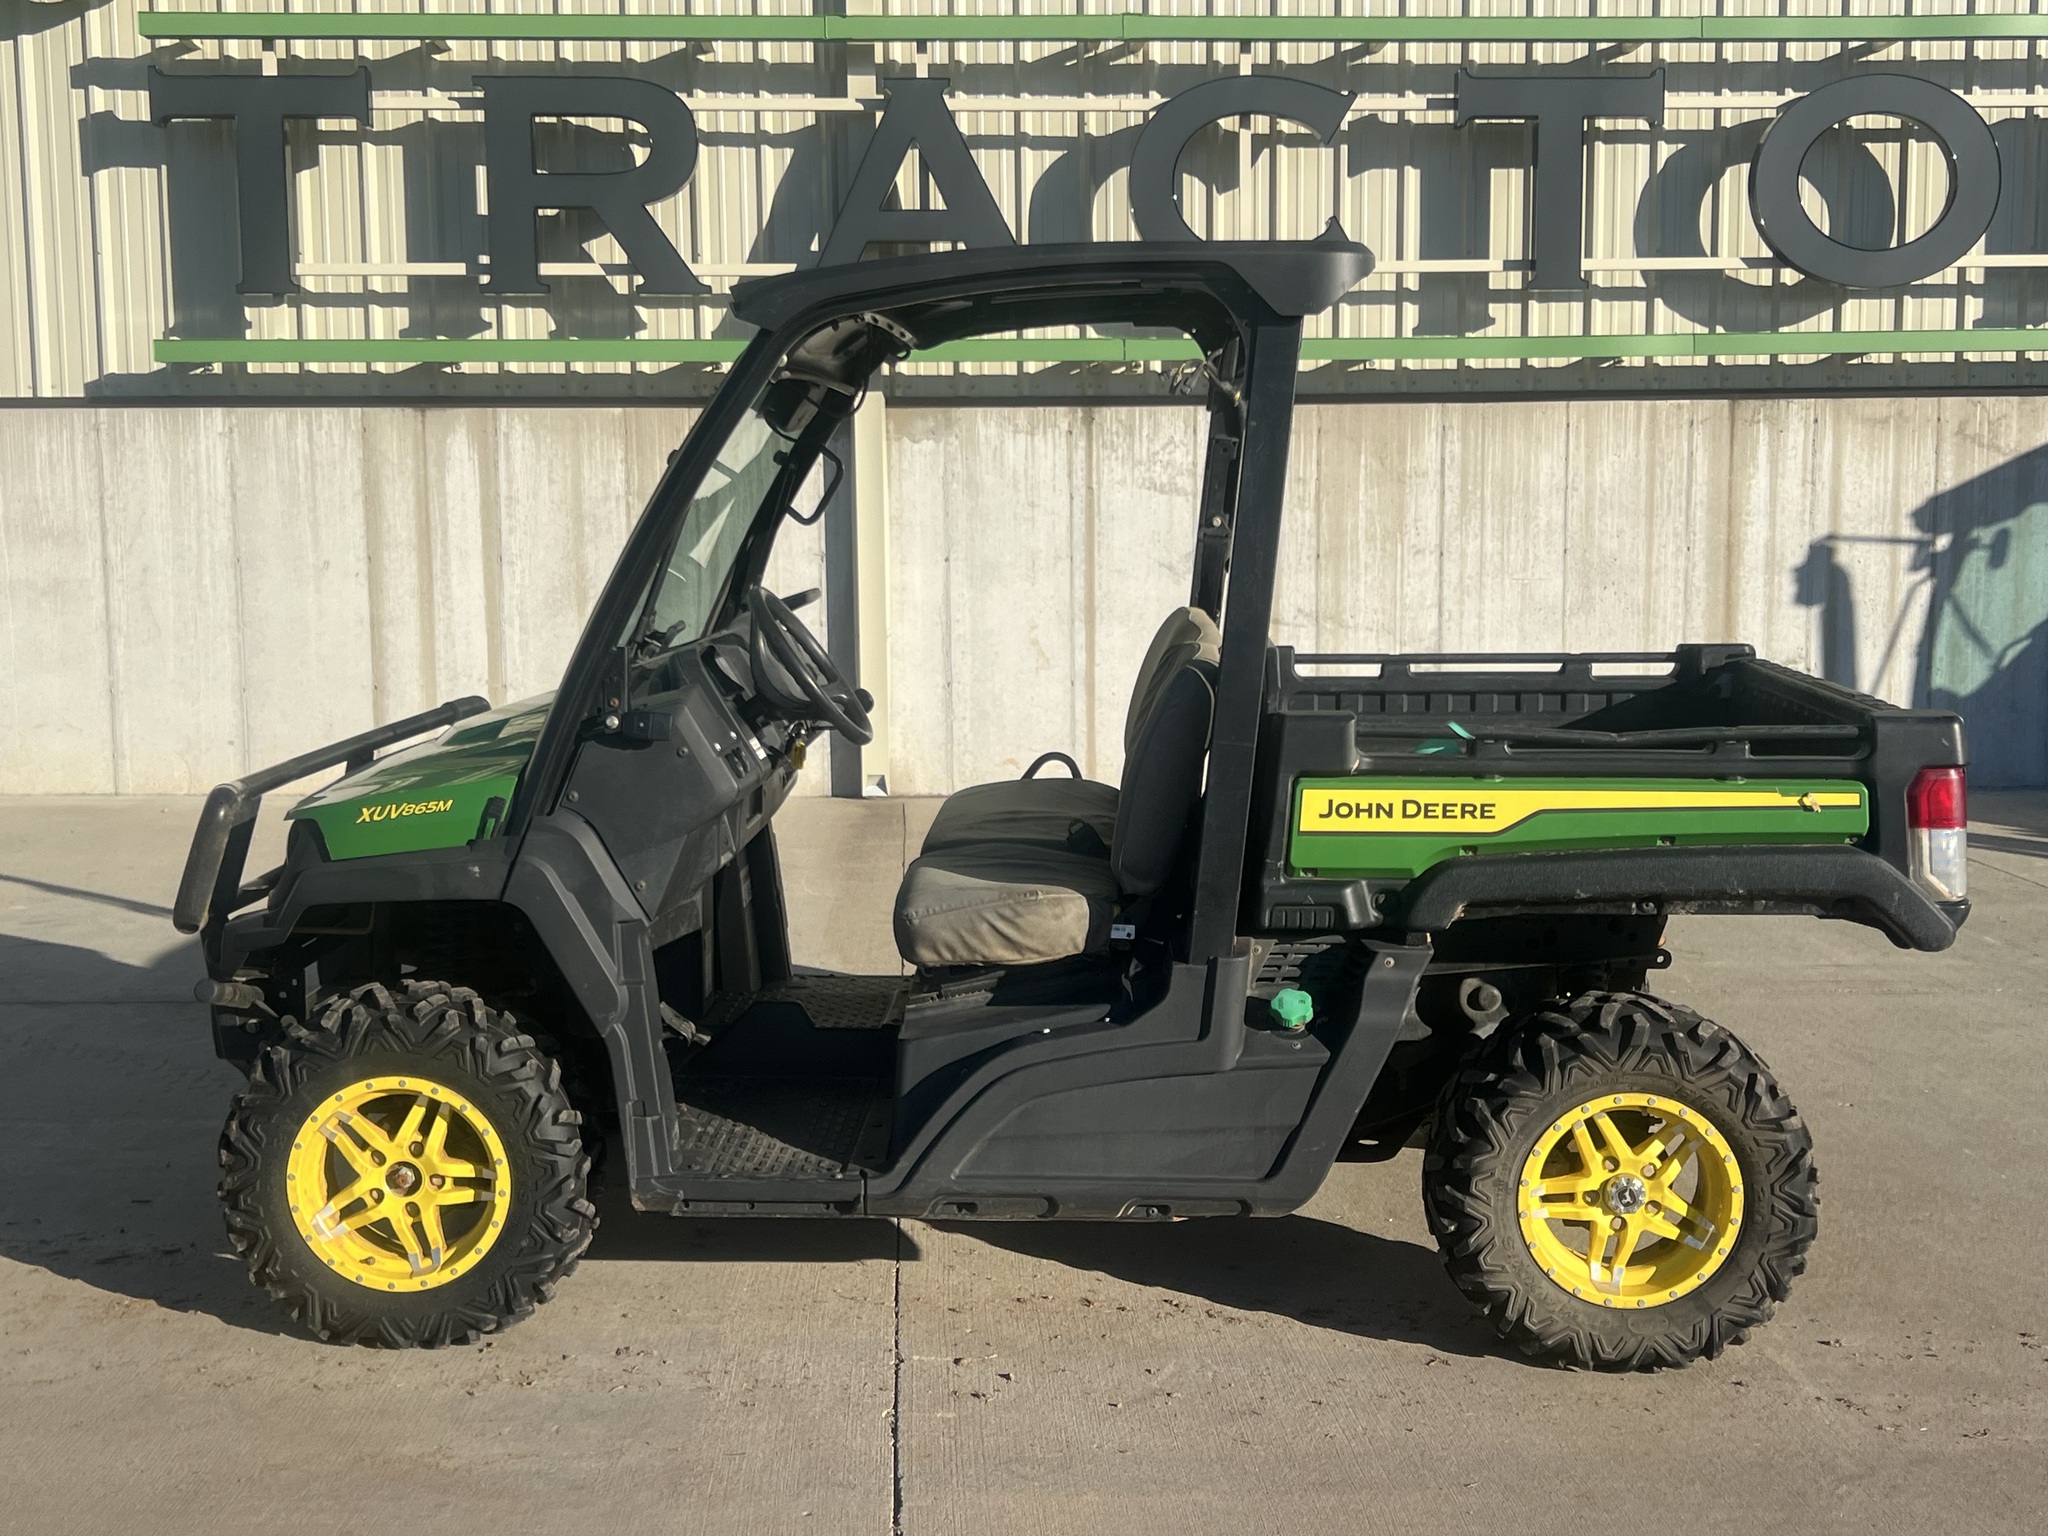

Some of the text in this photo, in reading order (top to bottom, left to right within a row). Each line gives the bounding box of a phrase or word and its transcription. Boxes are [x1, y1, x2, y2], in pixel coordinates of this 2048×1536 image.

[355, 798, 454, 824] XUV865M
[1318, 798, 1497, 820] JOHN DEERE
